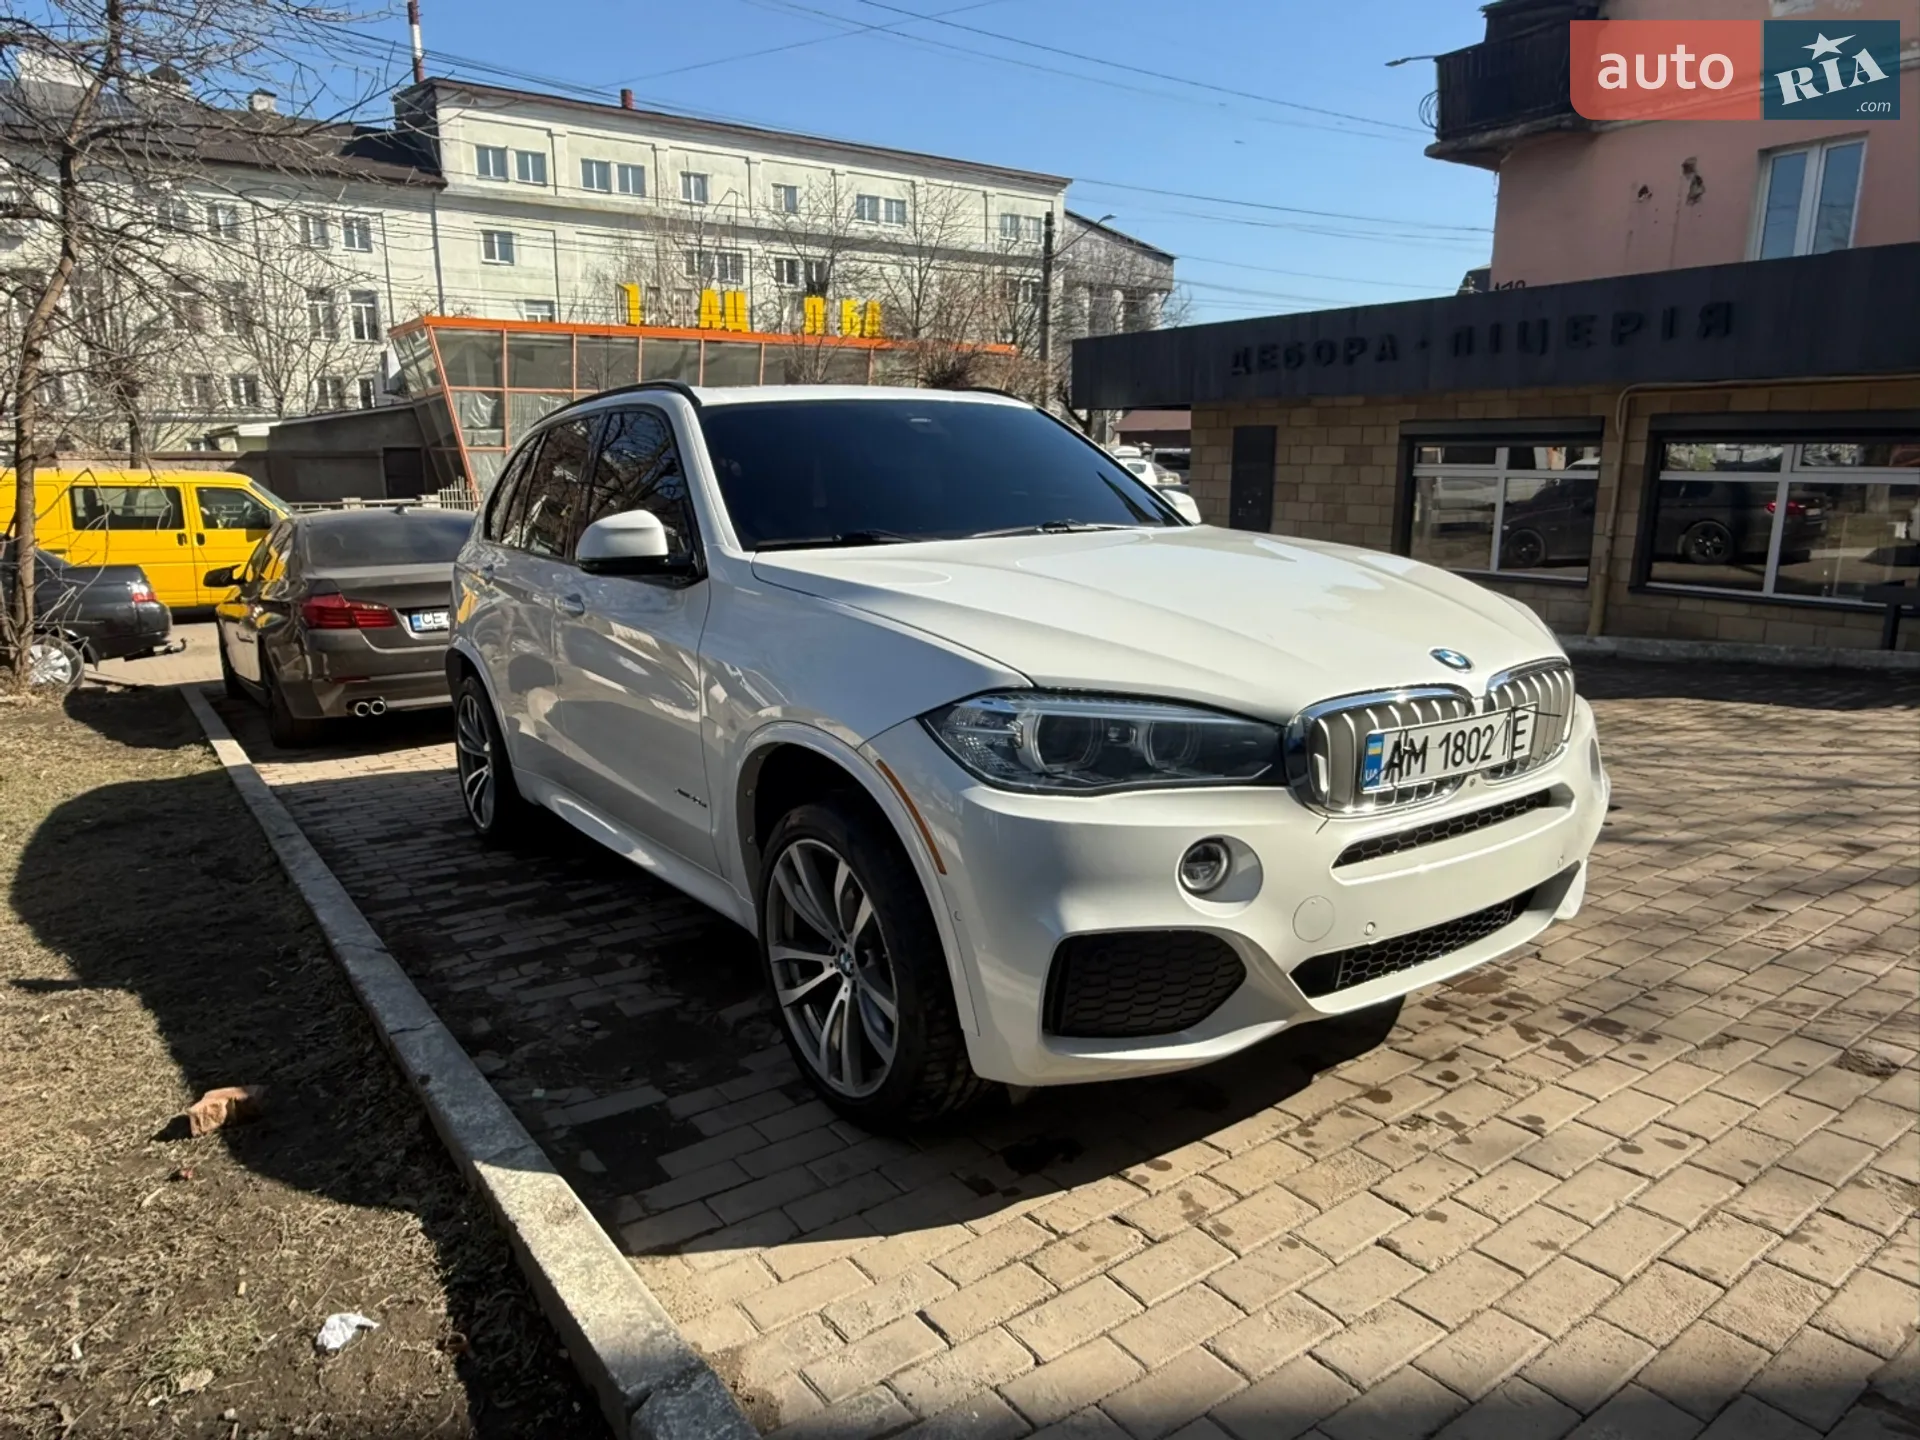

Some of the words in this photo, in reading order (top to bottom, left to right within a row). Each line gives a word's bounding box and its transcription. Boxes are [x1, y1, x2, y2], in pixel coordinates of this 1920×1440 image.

[1231, 333, 1399, 376] ДЕБОРА
[1453, 301, 1735, 358] ПІЦЕРІЯ
[1383, 735, 1429, 781] AM
[1438, 724, 1495, 771] 1802
